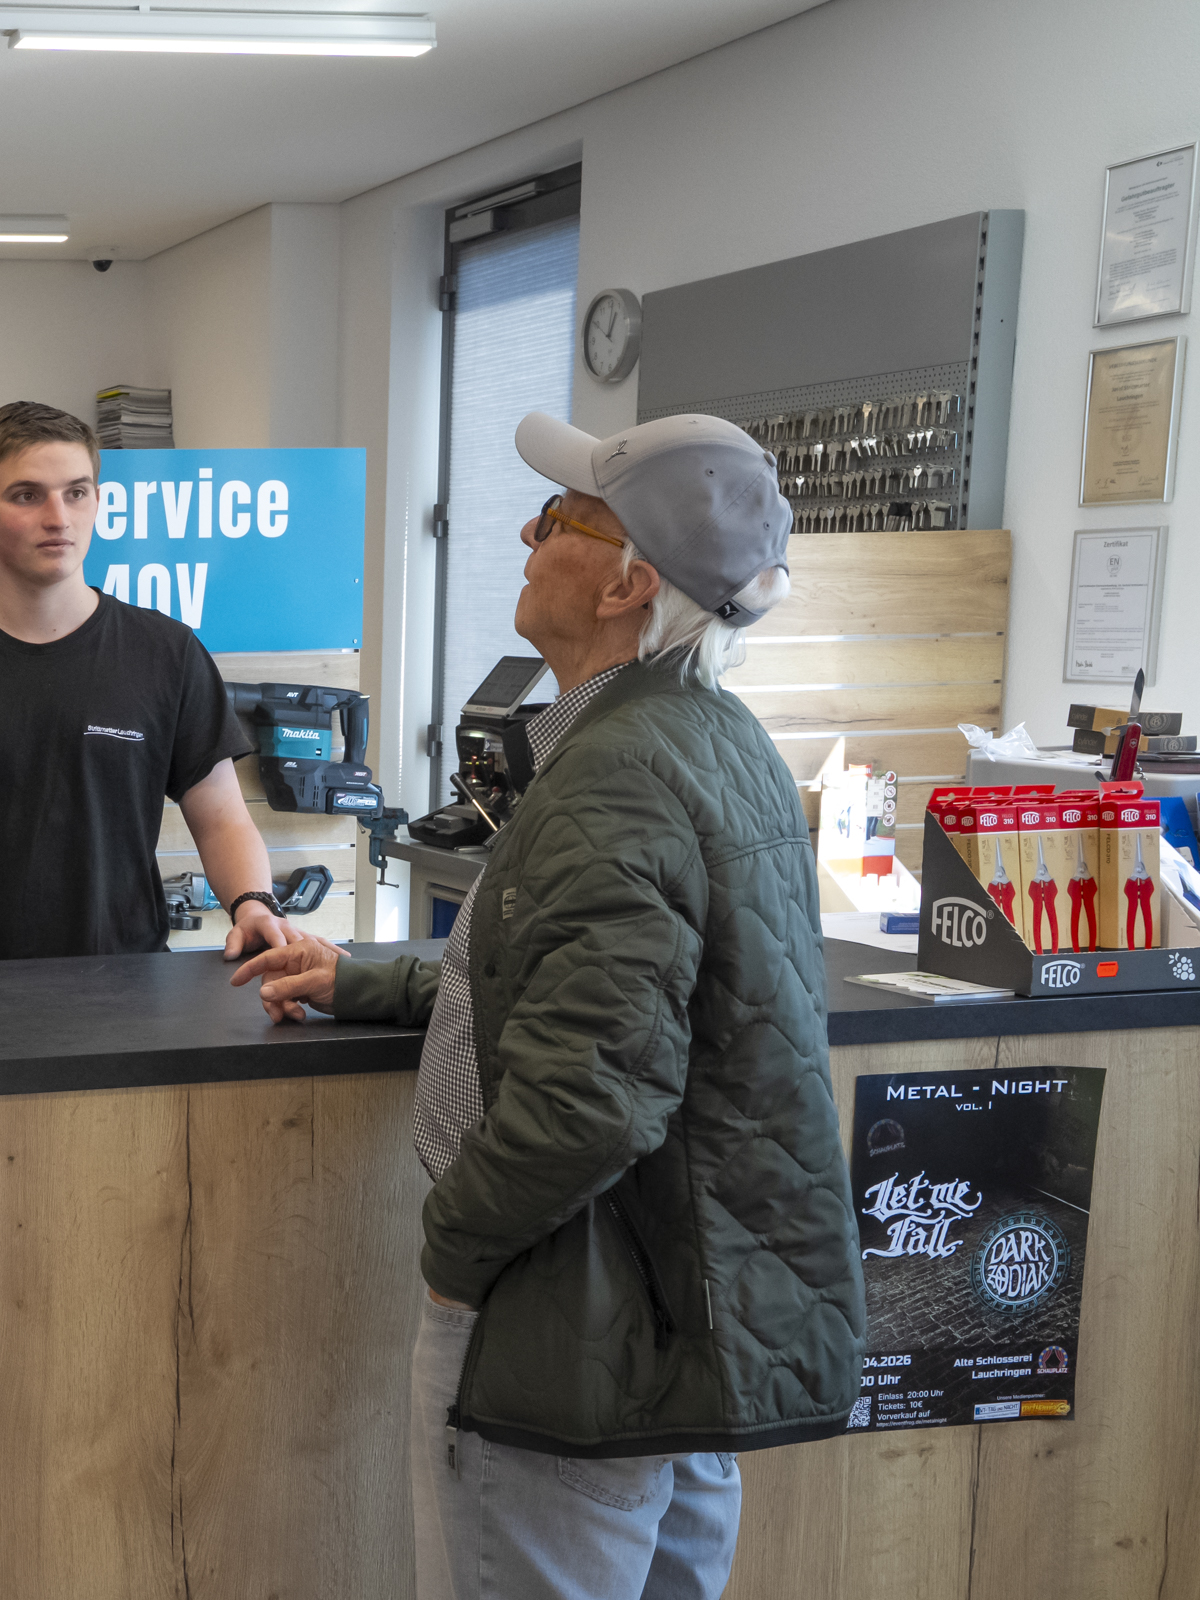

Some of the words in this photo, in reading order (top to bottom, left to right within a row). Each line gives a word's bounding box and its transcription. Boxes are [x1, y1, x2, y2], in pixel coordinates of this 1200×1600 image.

[94, 468, 289, 541] ervice
[1109, 557, 1120, 566] EN
[282, 728, 320, 740] Makita
[980, 813, 998, 826] FELCO
[1021, 811, 1040, 825] FELCO
[1062, 809, 1081, 823] FELCO
[1121, 808, 1140, 822] FELCO
[931, 896, 987, 948] FELCO
[1040, 960, 1081, 988] FELCO
[862, 1170, 933, 1223] Let
[928, 1178, 983, 1218] me
[862, 1210, 964, 1260] Fall
[990, 1230, 1051, 1265] DARK
[986, 1262, 1051, 1298] ZODIAK
[953, 1358, 974, 1368] Alte
[975, 1353, 1033, 1366] Schlosserei
[878, 1374, 902, 1386] Uhr
[971, 1368, 1032, 1380] Lauchringen
[878, 1393, 904, 1401] Einlass
[907, 1390, 929, 1399] 20:00
[930, 1389, 944, 1397] Uhr
[878, 1402, 907, 1410] Tickets:
[910, 1400, 923, 1409] 10€
[877, 1411, 917, 1421] Vorverkauf
[918, 1410, 931, 1418] auf
